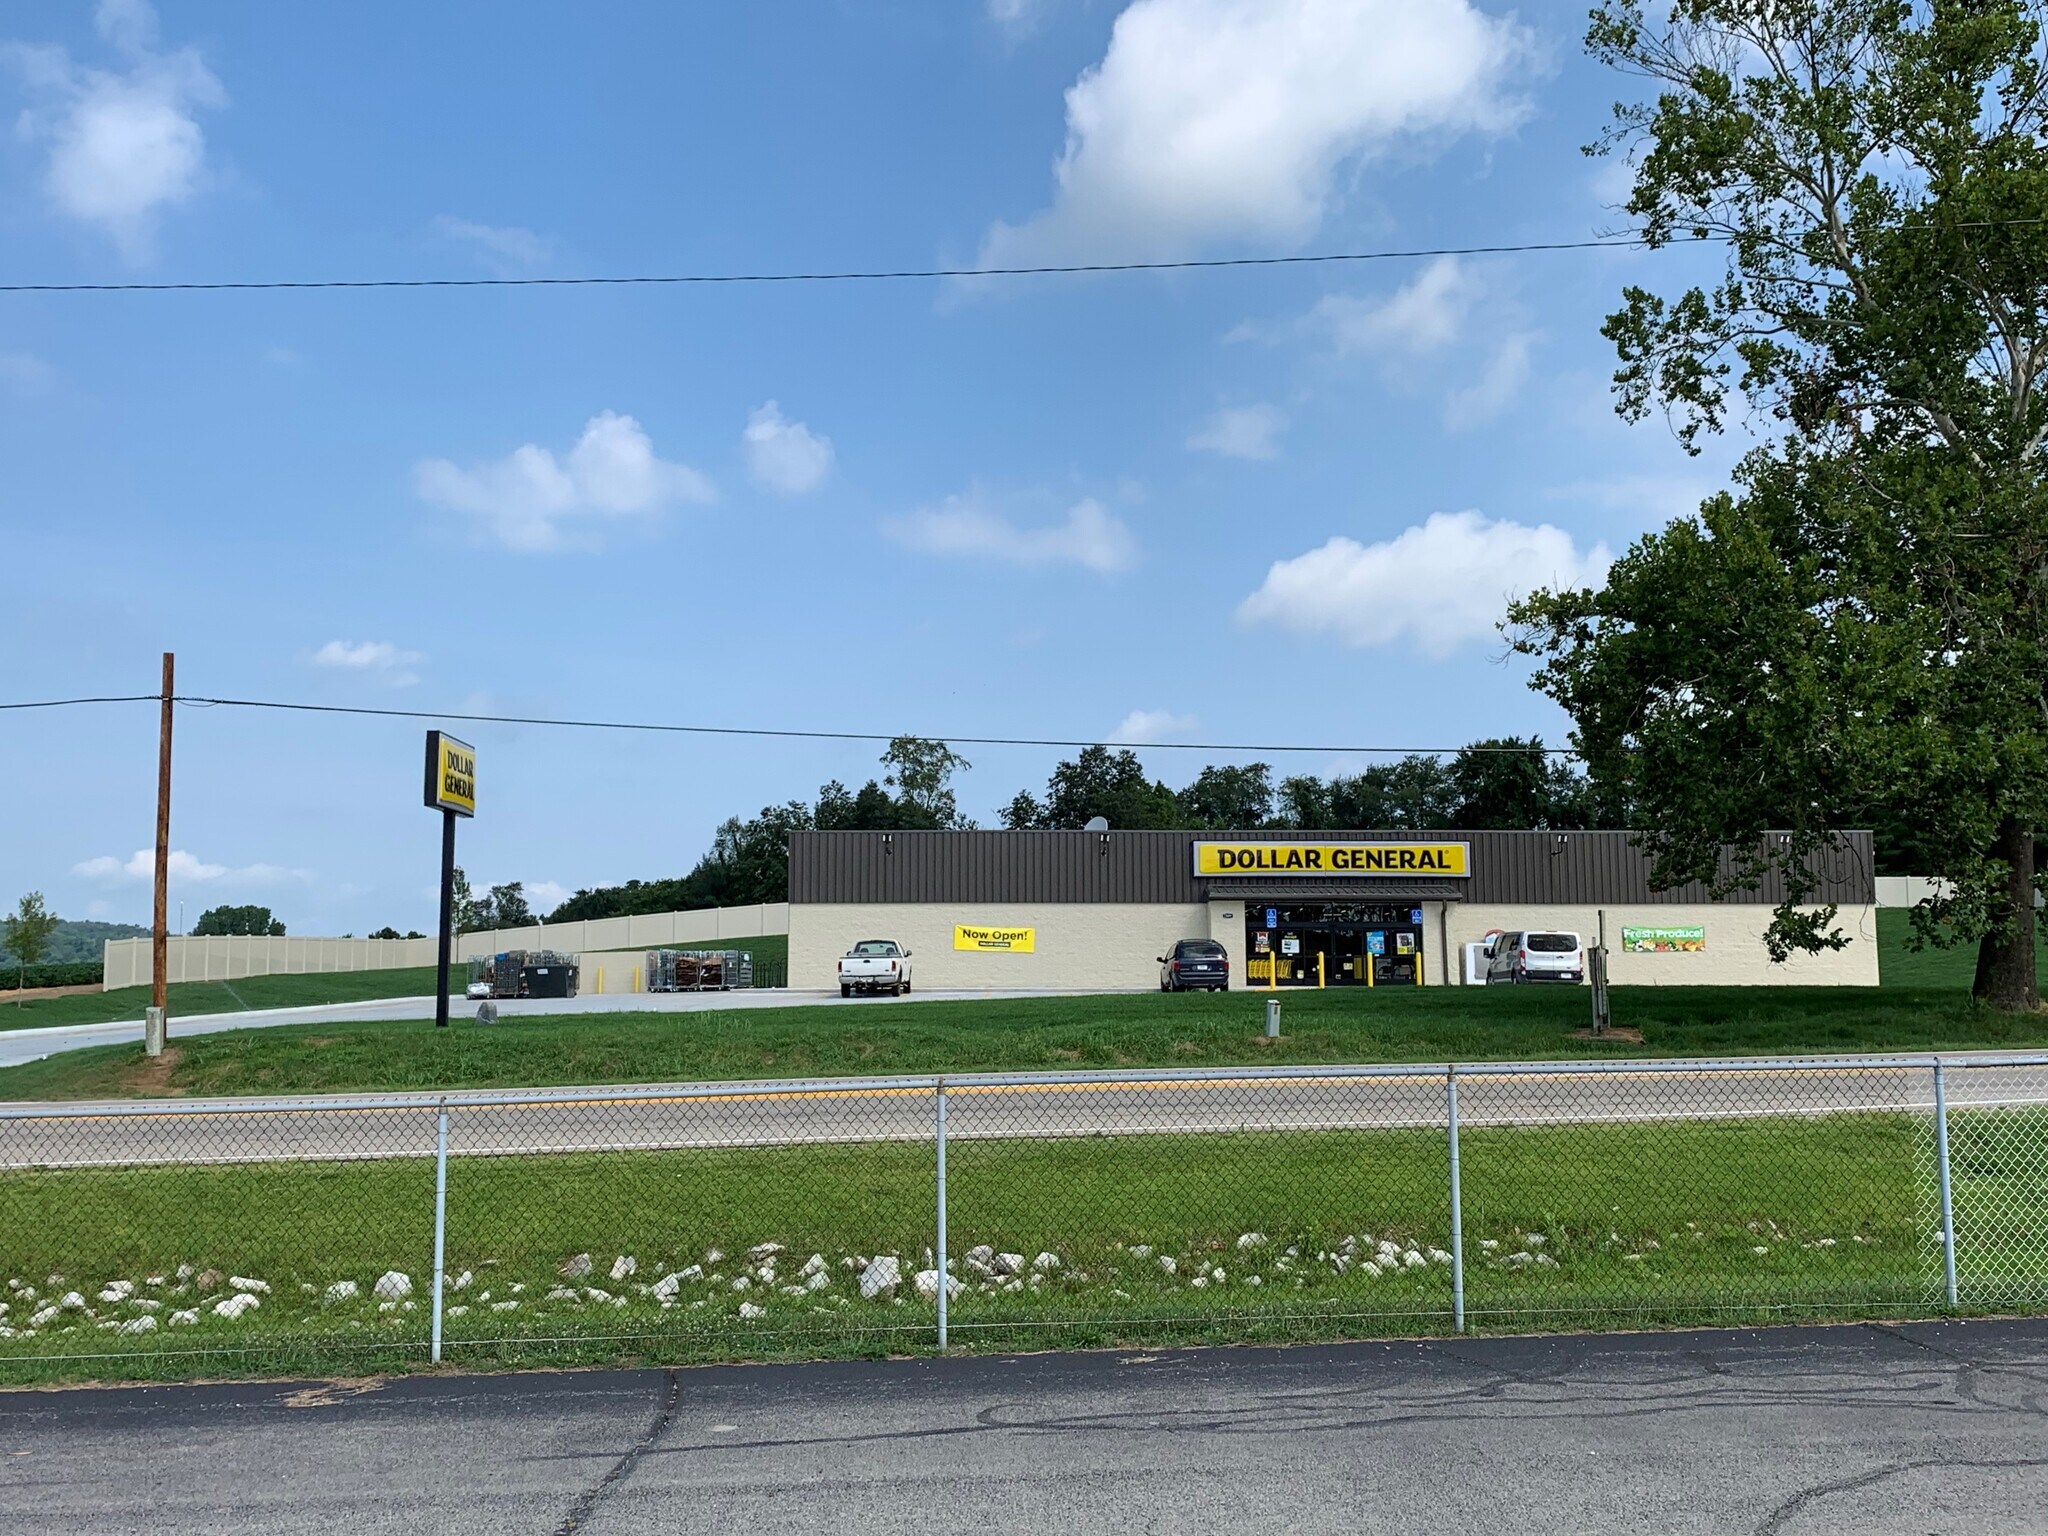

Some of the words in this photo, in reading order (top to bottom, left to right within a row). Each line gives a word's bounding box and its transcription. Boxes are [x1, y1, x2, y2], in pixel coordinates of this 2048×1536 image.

[447, 750, 474, 778] DOLLAR
[444, 774, 474, 801] GENERAL
[1217, 849, 1322, 869] DOLLAR
[1332, 849, 1451, 870] GENERAL
[962, 929, 988, 939] Now
[992, 931, 1028, 942] Open!
[1624, 928, 1654, 938] Fresh
[1656, 928, 1704, 938] Produce!
